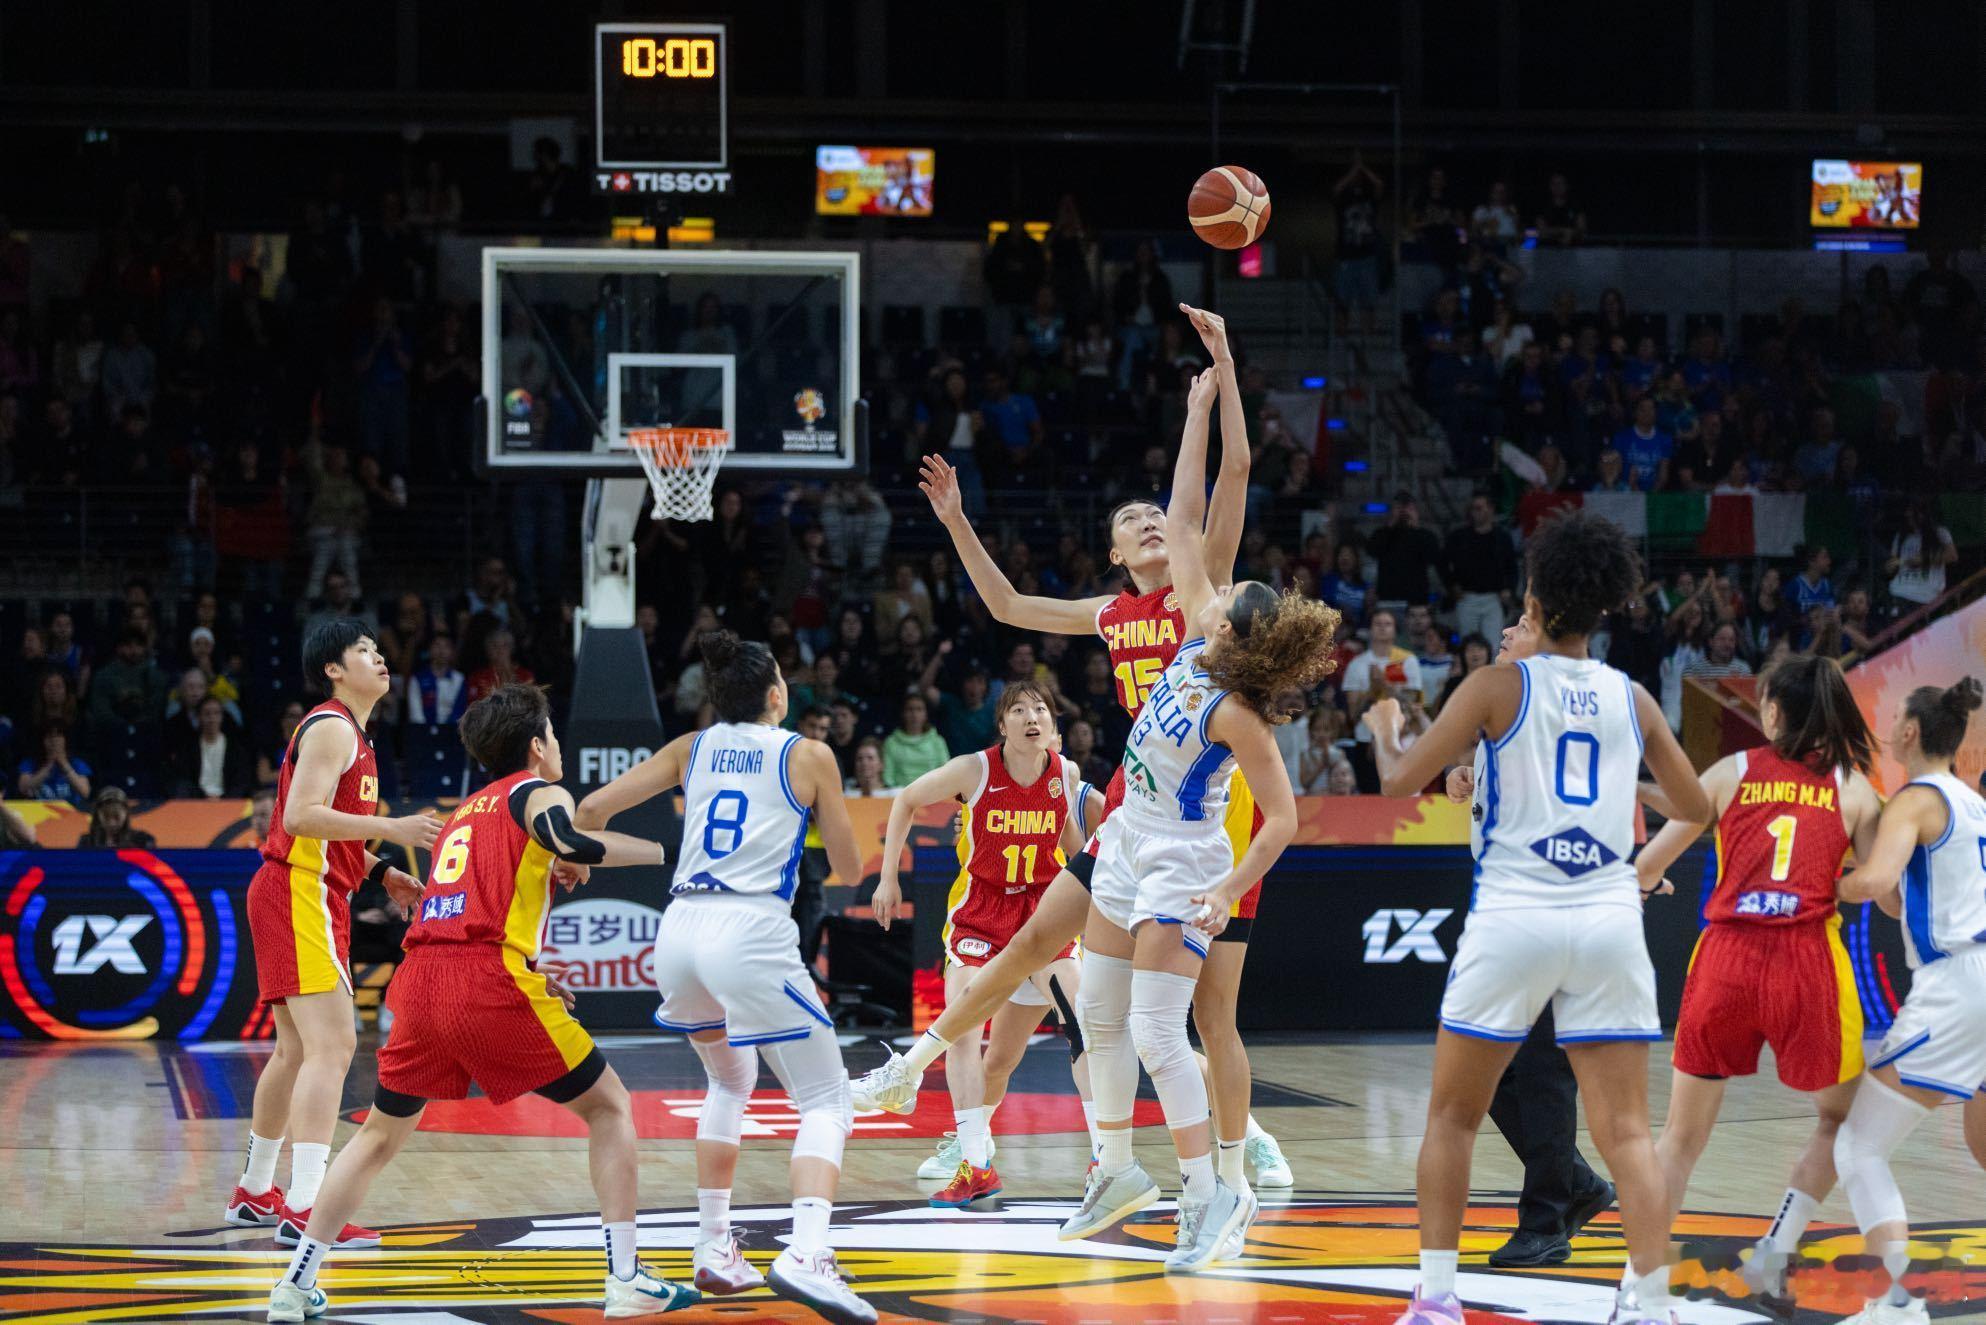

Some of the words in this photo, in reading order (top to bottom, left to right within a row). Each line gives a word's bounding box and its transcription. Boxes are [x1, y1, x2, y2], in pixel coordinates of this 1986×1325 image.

[623, 39, 714, 77] 10:00
[633, 172, 731, 192] TISSOT
[1114, 657, 1164, 709] 15
[1149, 671, 1193, 748] TALIA
[711, 749, 763, 774] VERONA
[1556, 730, 1600, 806] 0
[1740, 781, 1796, 805] ZHANG
[703, 789, 749, 860] 8
[986, 809, 1056, 834] CHINA
[433, 825, 472, 885] 6
[1002, 844, 1038, 884] 11
[1546, 838, 1604, 867] IBSA
[1767, 814, 1798, 882] 1
[52, 914, 154, 975] 1X
[550, 913, 659, 946] 百岁山
[1362, 908, 1454, 963] 1X
